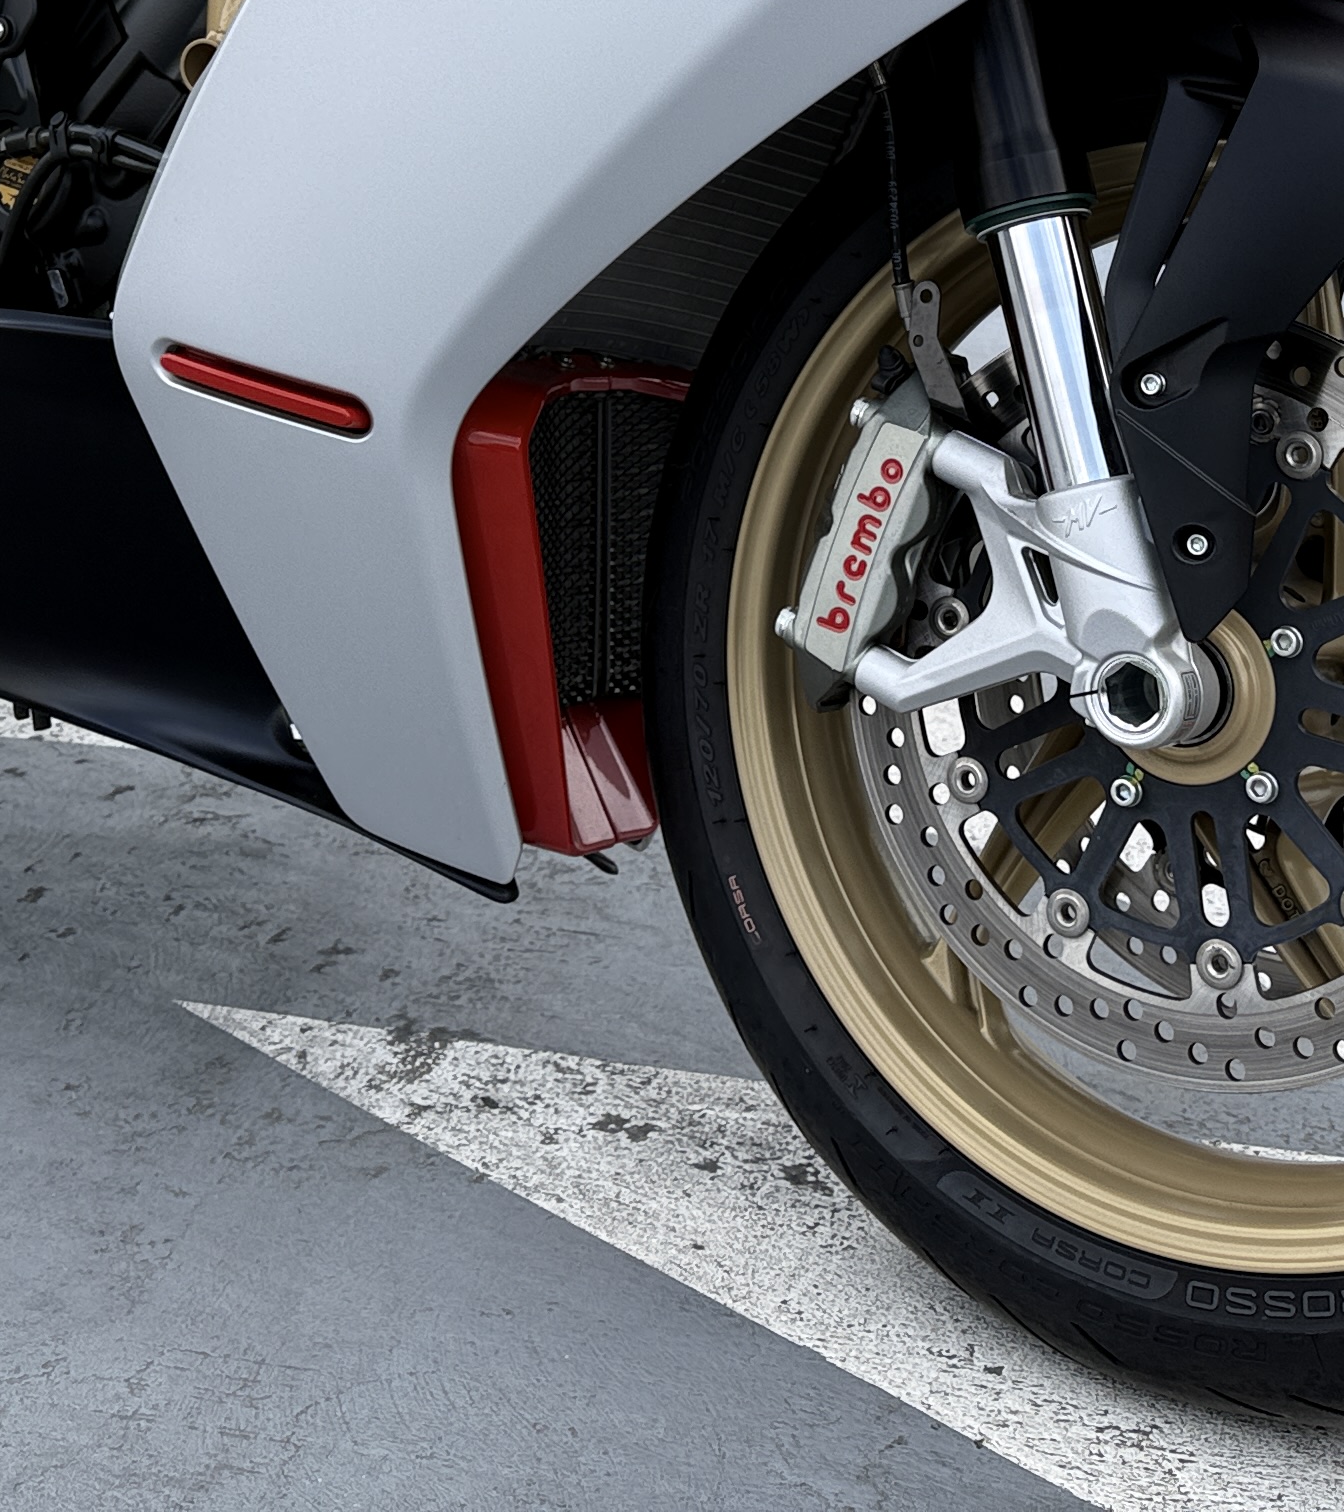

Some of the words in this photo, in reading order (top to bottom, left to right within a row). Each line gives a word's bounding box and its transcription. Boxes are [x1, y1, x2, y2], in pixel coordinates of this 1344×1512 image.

[715, 428, 745, 510] M/C
[816, 457, 905, 634] brembo
[692, 583, 711, 644] ZR
[693, 663, 724, 808] 120/70
[727, 874, 763, 946] CORSA
[1030, 1226, 1153, 1290] CORSA
